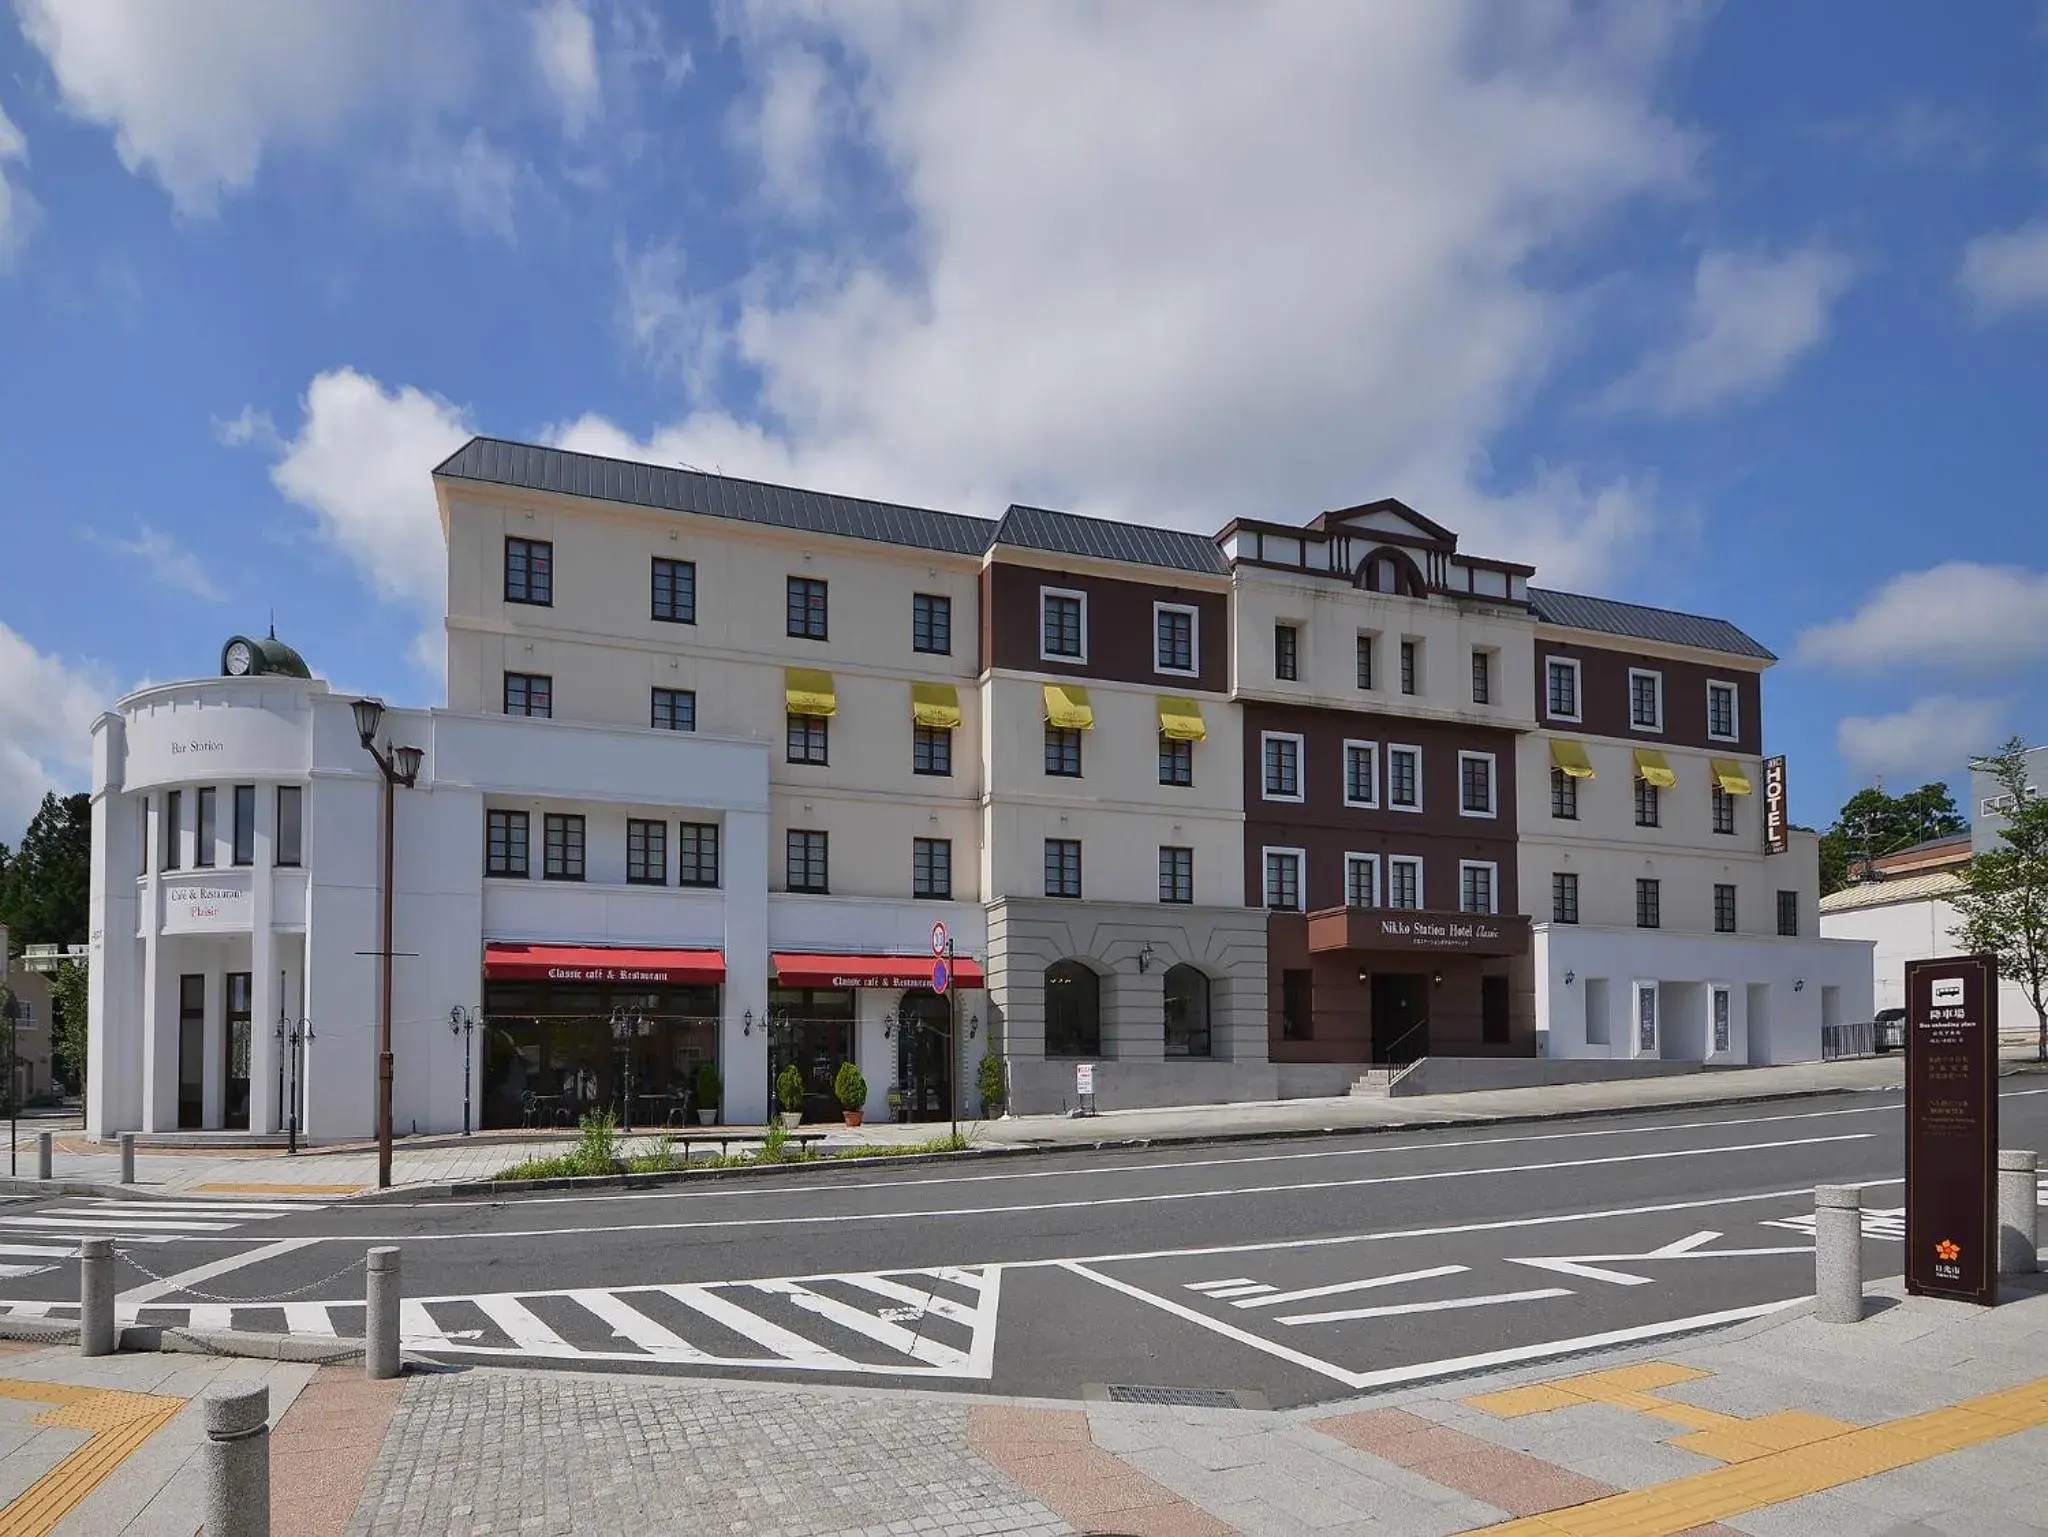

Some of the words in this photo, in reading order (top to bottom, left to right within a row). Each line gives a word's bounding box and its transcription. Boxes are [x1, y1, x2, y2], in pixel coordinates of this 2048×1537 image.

[171, 742, 187, 755] Bar
[189, 739, 224, 753] Station
[1766, 766, 1782, 842] HOTEL
[1381, 921, 1411, 935] Nikko
[1413, 922, 1446, 936] Station
[1449, 924, 1473, 937] Hotel
[548, 968, 582, 979] Classic
[619, 969, 668, 981] Restaurant
[832, 976, 861, 987] Classic
[893, 977, 934, 988] Restauran
